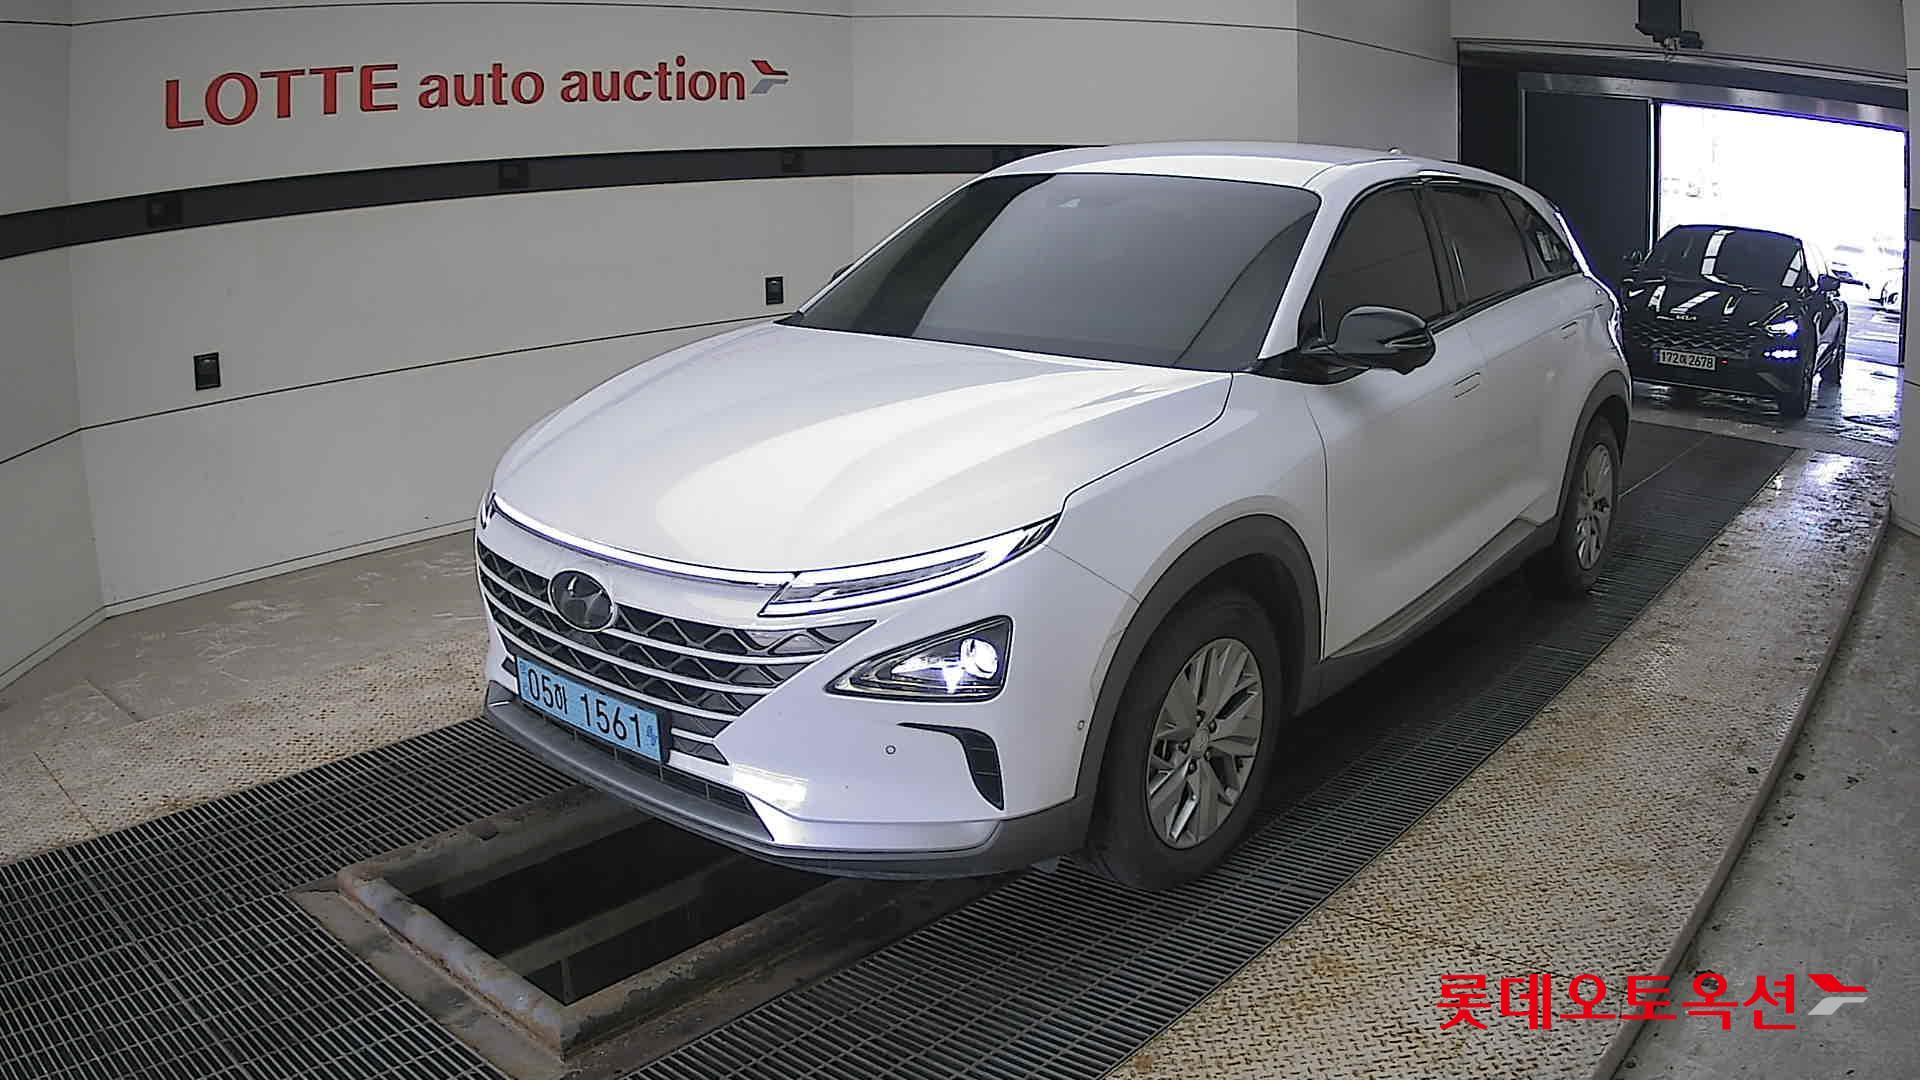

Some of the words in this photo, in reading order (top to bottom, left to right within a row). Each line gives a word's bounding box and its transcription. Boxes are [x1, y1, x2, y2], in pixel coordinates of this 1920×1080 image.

[165, 62, 399, 129] LOTTE
[418, 62, 545, 109] auto
[560, 55, 745, 103] auction
[527, 668, 568, 715] 05하
[580, 693, 641, 748] 1561
